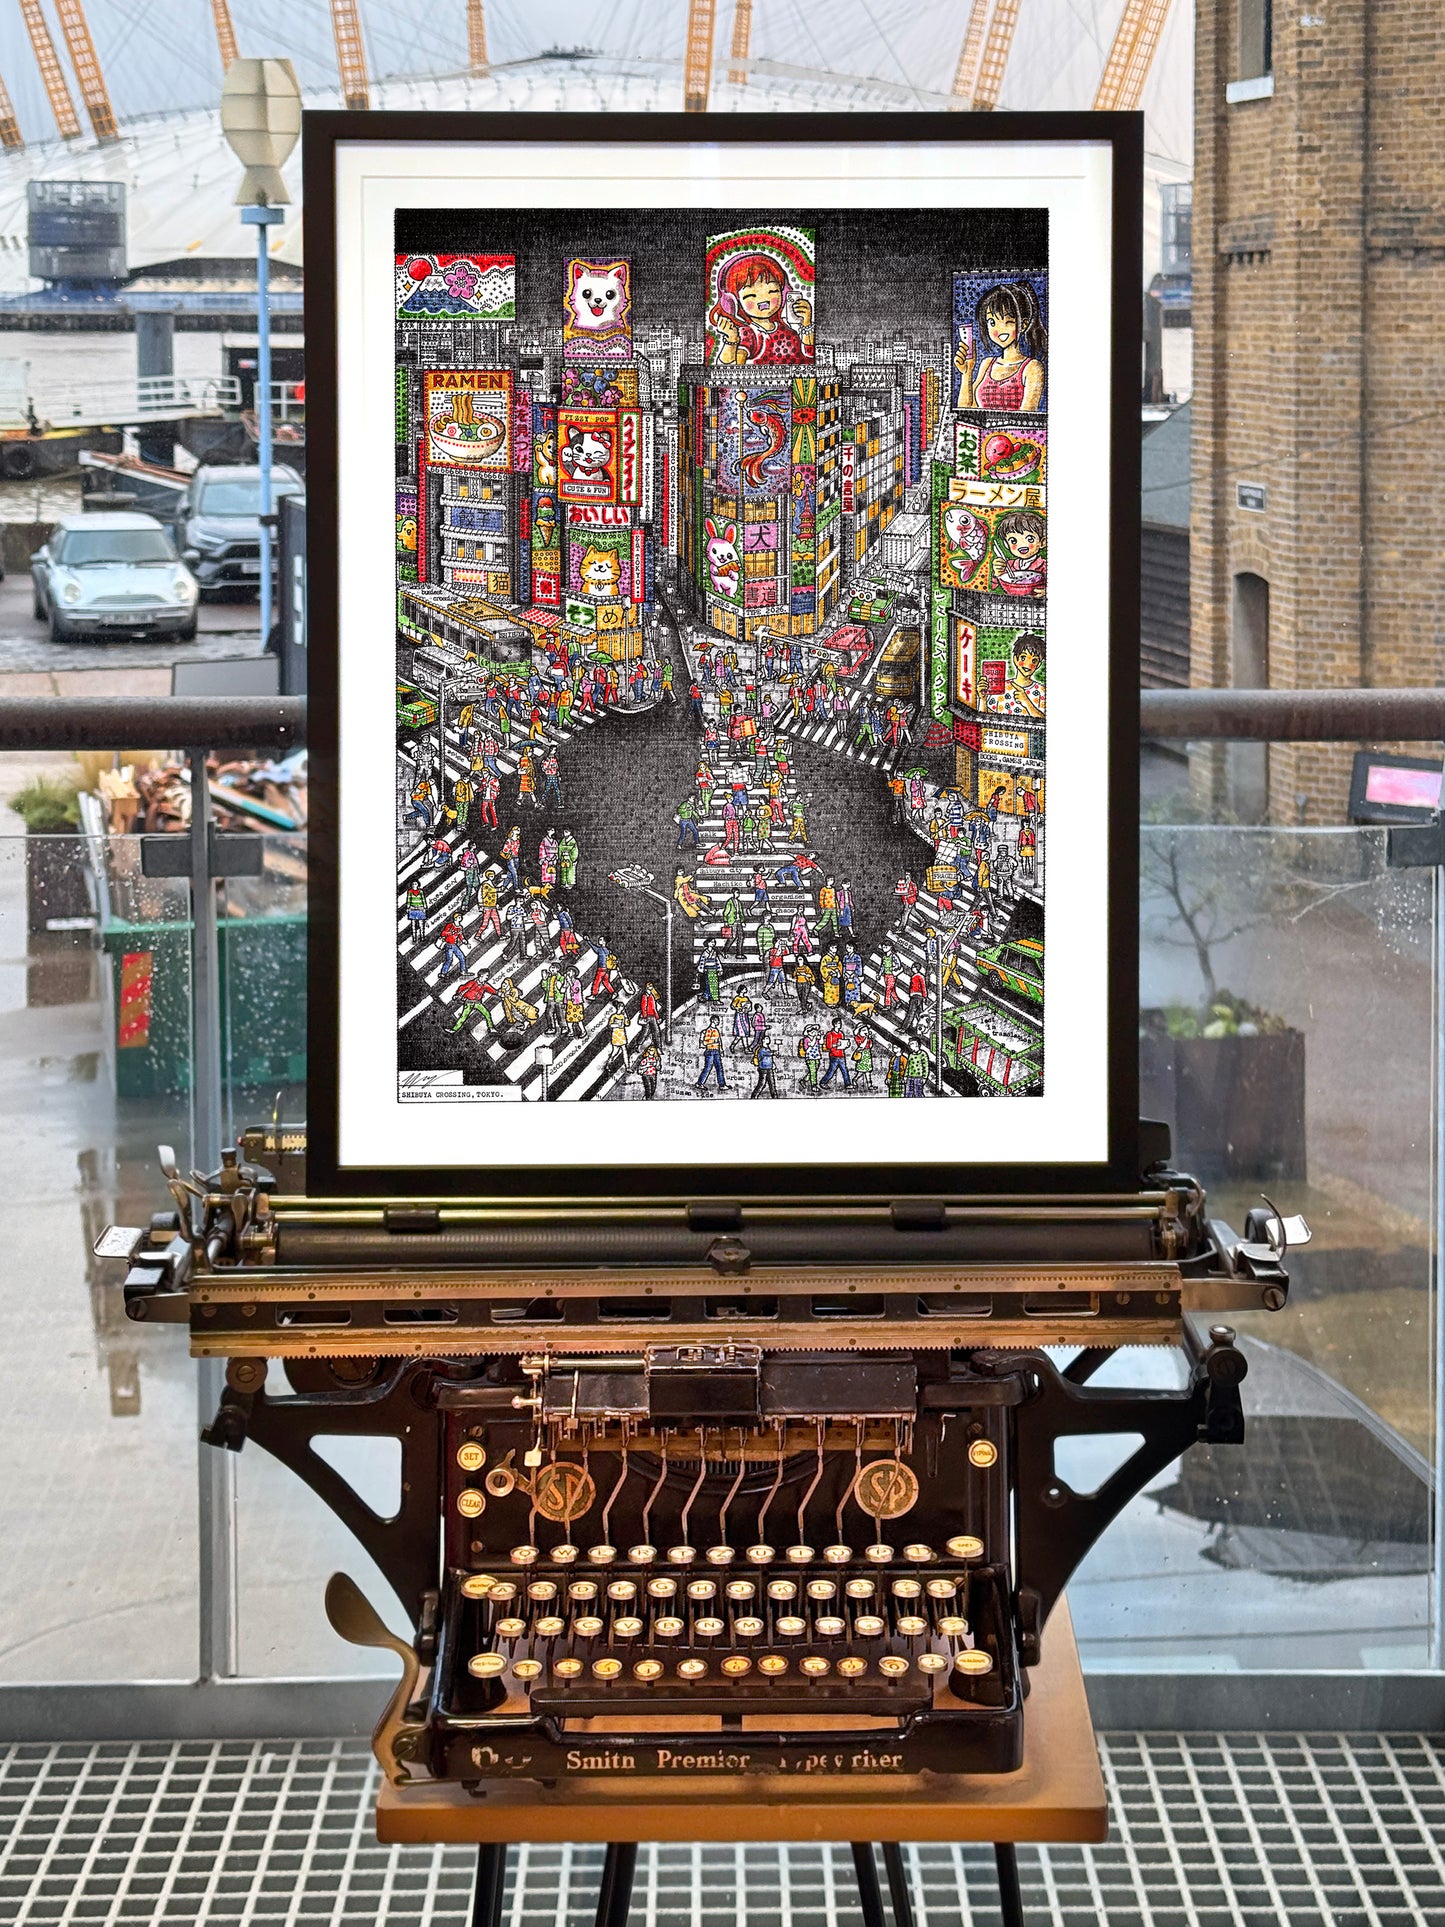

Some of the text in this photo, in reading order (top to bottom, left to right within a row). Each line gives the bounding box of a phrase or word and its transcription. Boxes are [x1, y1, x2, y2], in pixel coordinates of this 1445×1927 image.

[432, 374, 503, 389] RAMEN
[564, 414, 589, 422] FIZZY
[957, 429, 978, 476] お茶
[566, 485, 585, 493] CUTE
[951, 481, 1042, 508] ラーメン屋
[568, 505, 629, 524] おいしい
[750, 525, 771, 549] 犬
[492, 574, 509, 592] 猫
[746, 586, 777, 604] 書道
[960, 627, 973, 702] ケーキ
[984, 730, 1019, 740] SHIBUYA
[982, 738, 1024, 749] CROSSING
[463, 1452, 480, 1461] SET
[461, 1498, 481, 1508] CLEAR
[519, 1550, 530, 1558] Q
[558, 1549, 573, 1557] W
[655, 1582, 668, 1590] G
[696, 1585, 708, 1593] H
